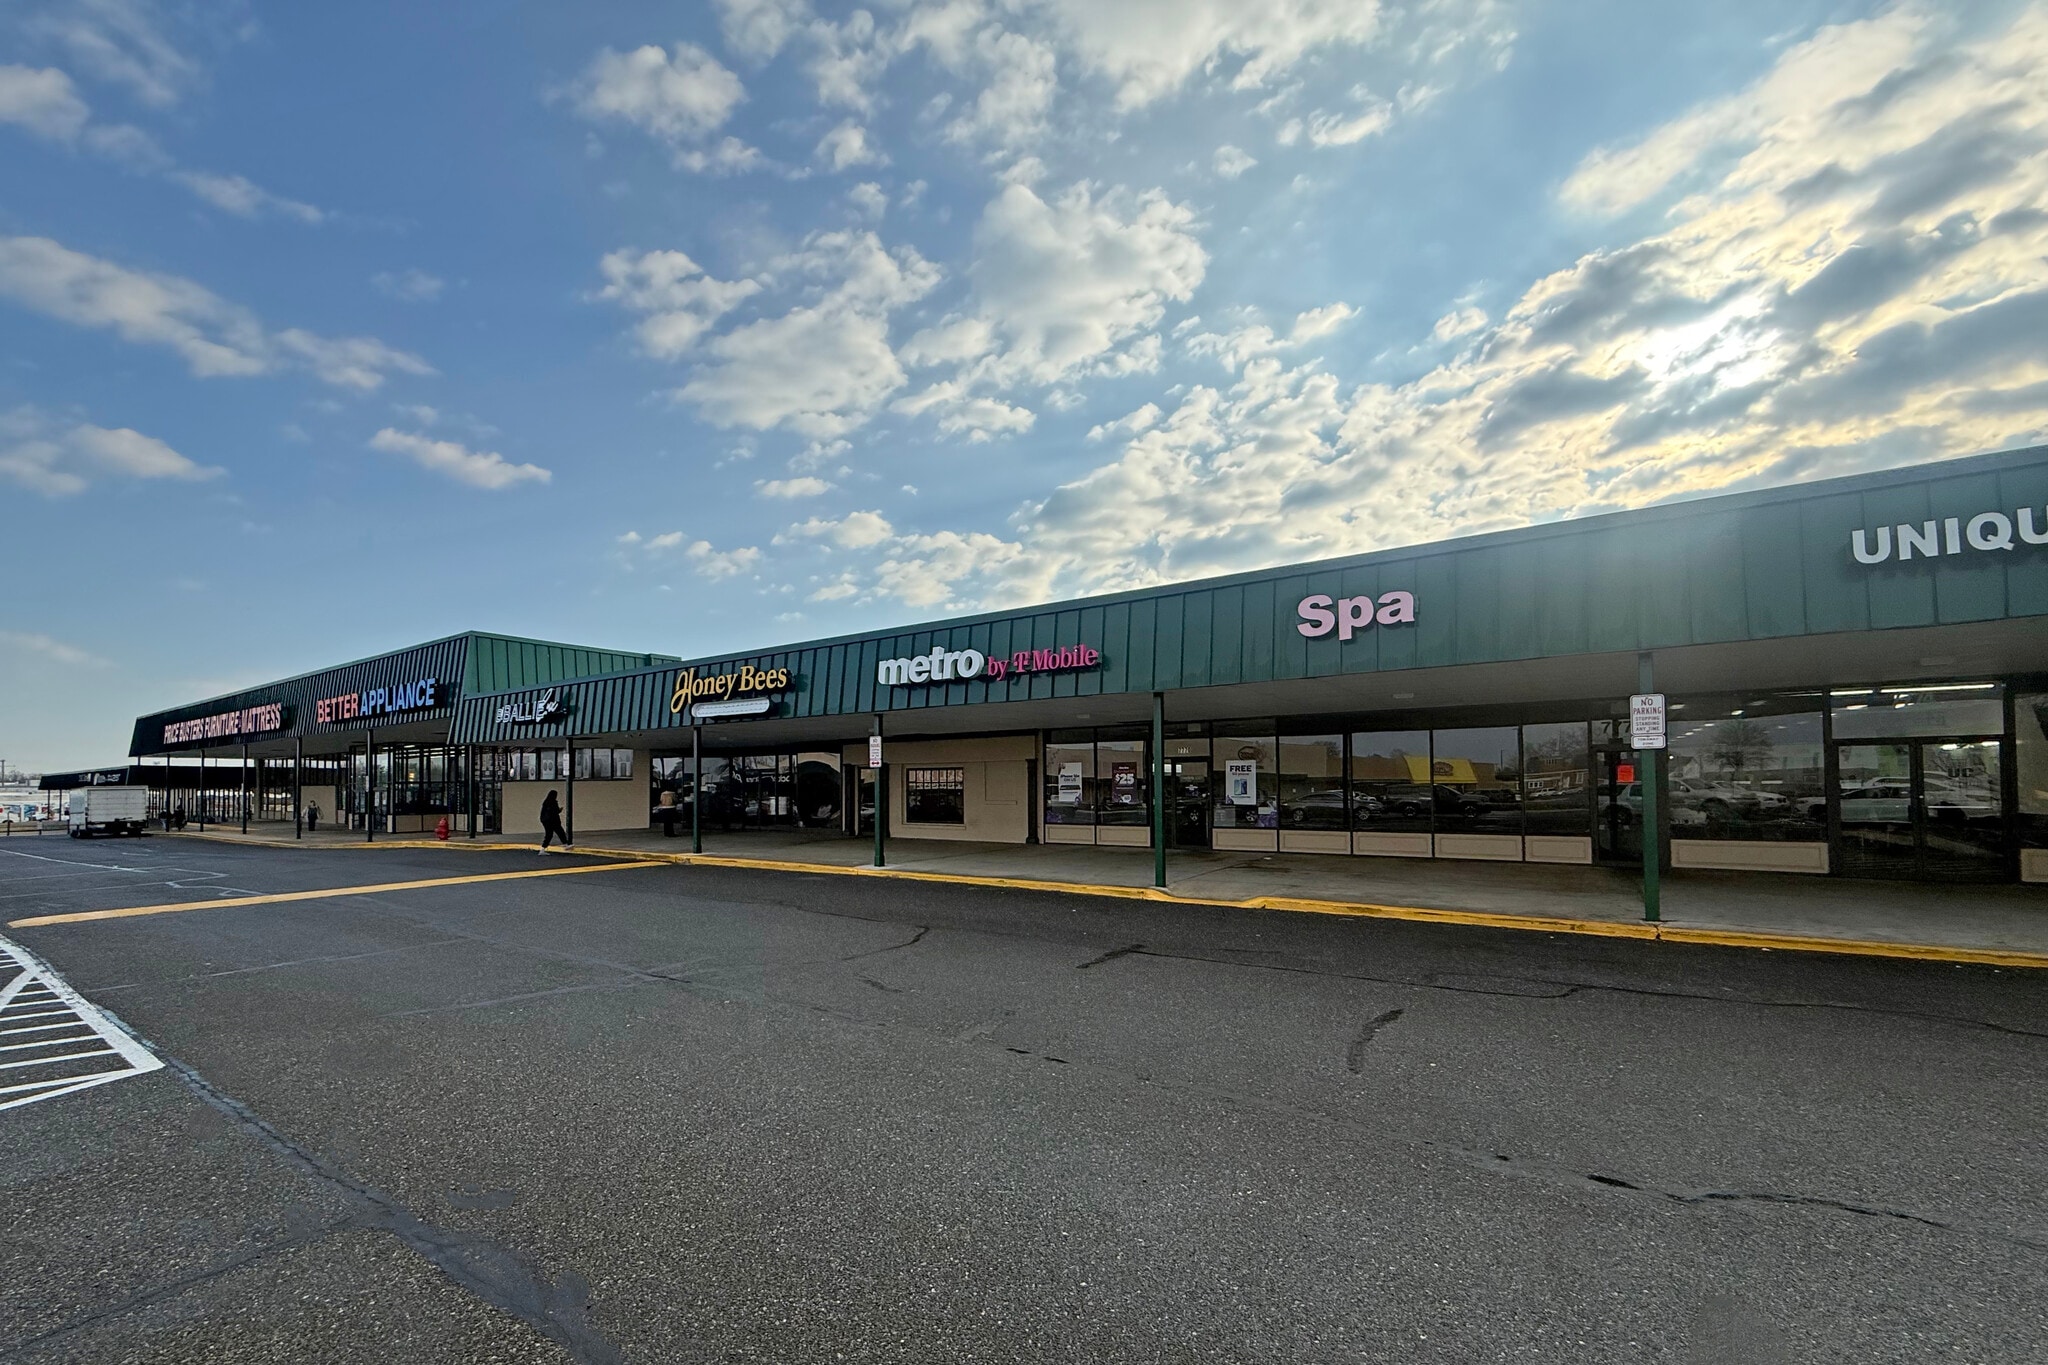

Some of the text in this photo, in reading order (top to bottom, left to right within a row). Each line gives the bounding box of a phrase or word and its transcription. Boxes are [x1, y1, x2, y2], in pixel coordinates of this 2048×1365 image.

[1851, 507, 2048, 565] UNIQU
[878, 646, 984, 686] metro
[987, 656, 1009, 681] by
[317, 678, 436, 723] BETTER APPLIANCE
[670, 667, 738, 713] Honey
[738, 665, 788, 692] Bees
[1641, 698, 1653, 706] NO
[163, 702, 282, 744] PRICE BUSTERS FURNITURE MATTRESS
[1633, 707, 1662, 715] PARKING
[1115, 773, 1135, 785] $25
